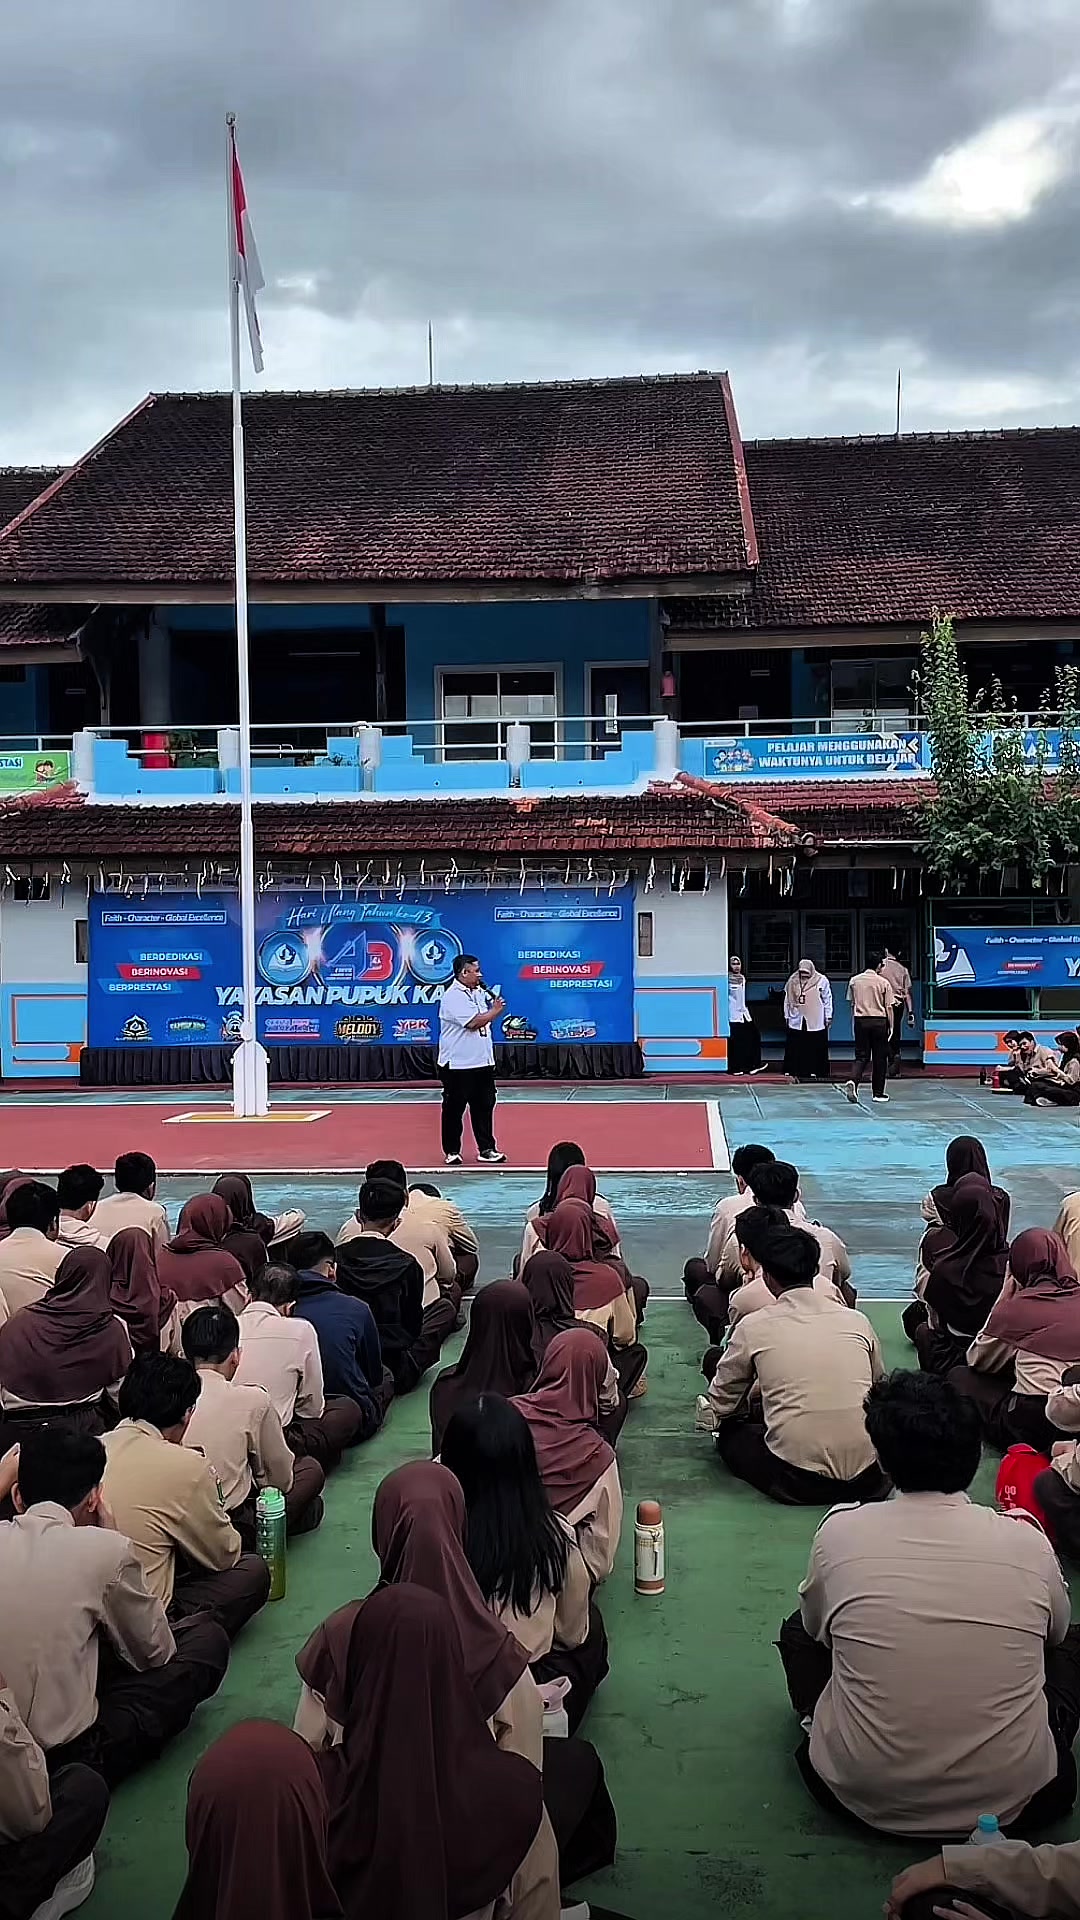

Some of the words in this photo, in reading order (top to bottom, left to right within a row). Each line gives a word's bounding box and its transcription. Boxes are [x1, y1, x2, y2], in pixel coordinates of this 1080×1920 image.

[767, 742, 814, 753] PELAJAR
[817, 738, 906, 752] MENGGUNAKAN
[758, 757, 823, 768] WAKTUNYA
[825, 755, 865, 766] UNTUK
[866, 753, 916, 764] BELAJAR
[286, 906, 317, 926] Hari
[139, 953, 203, 961] BERDEDIKASI
[517, 950, 581, 959] BERDEDIKASI
[532, 965, 591, 974] BERINOVASI
[1064, 956, 1080, 977] Y
[131, 967, 189, 976] BERINOVASI
[108, 983, 172, 991] BERPRESTASI
[549, 979, 613, 988] BERPRESTASI
[325, 985, 411, 1005] PUPUK
